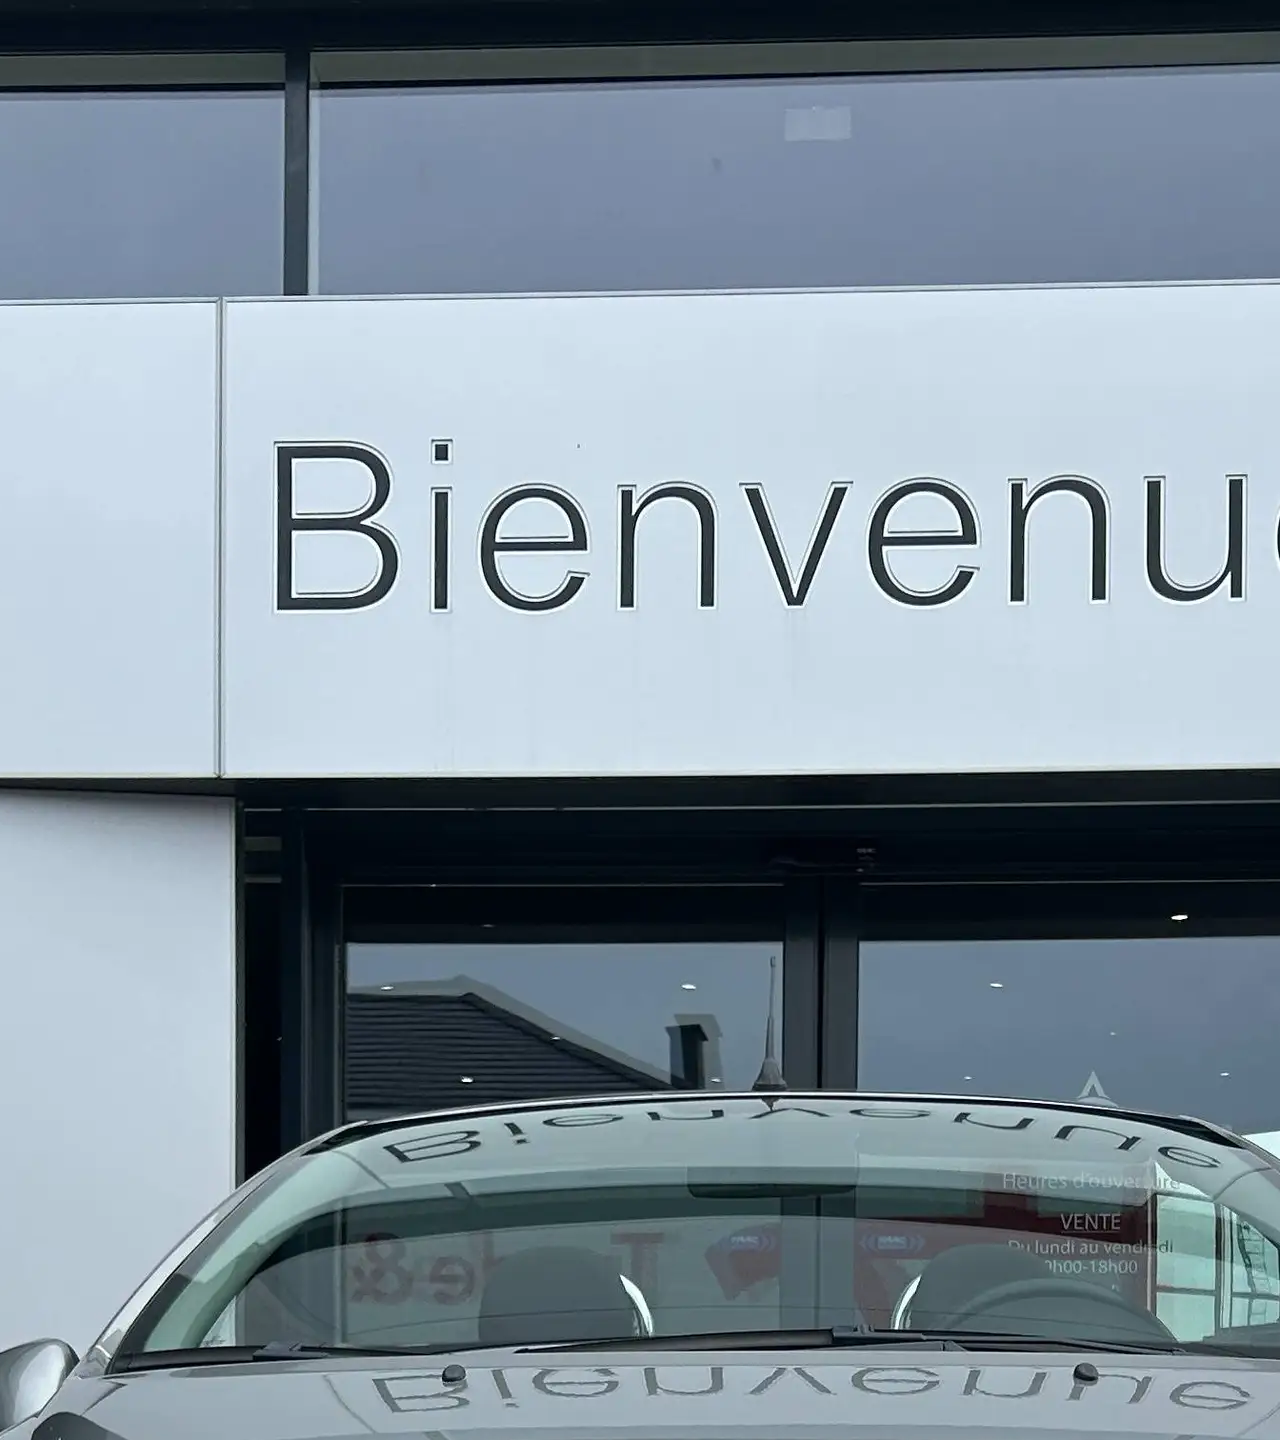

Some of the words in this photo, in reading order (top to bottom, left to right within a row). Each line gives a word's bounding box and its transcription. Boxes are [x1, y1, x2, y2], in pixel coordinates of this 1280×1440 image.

[1003, 1172, 1067, 1189] Heures
[1060, 1213, 1121, 1231] VENTE
[1035, 1240, 1075, 1254] lundi
[1080, 1243, 1099, 1254] au
[1104, 1240, 1173, 1254] vendrdi
